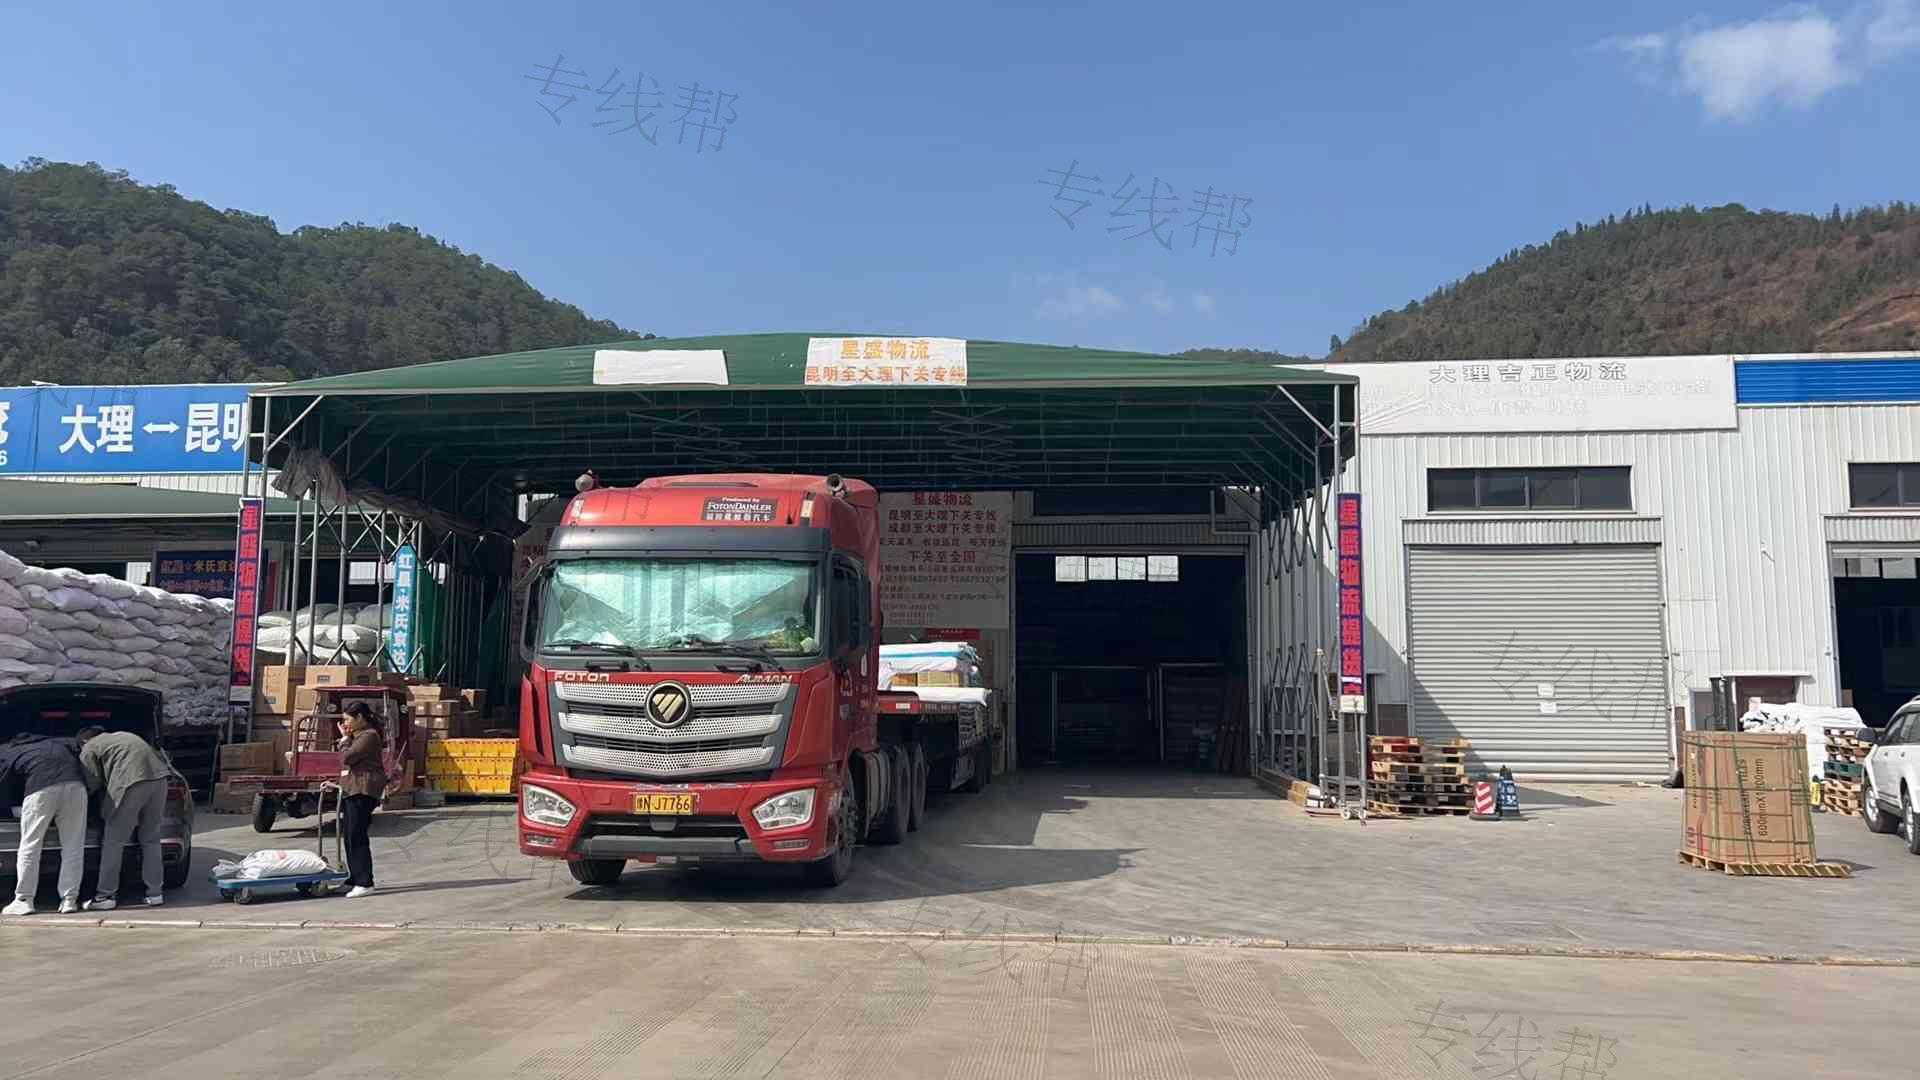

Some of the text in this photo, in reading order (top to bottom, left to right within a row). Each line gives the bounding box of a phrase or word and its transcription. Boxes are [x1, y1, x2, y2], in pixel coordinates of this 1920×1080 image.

[841, 340, 930, 359] 星盛物流
[806, 366, 966, 383] 昆明至大理下关专线
[1430, 362, 1626, 383] 大理吉正物流
[59, 404, 135, 454] 大理
